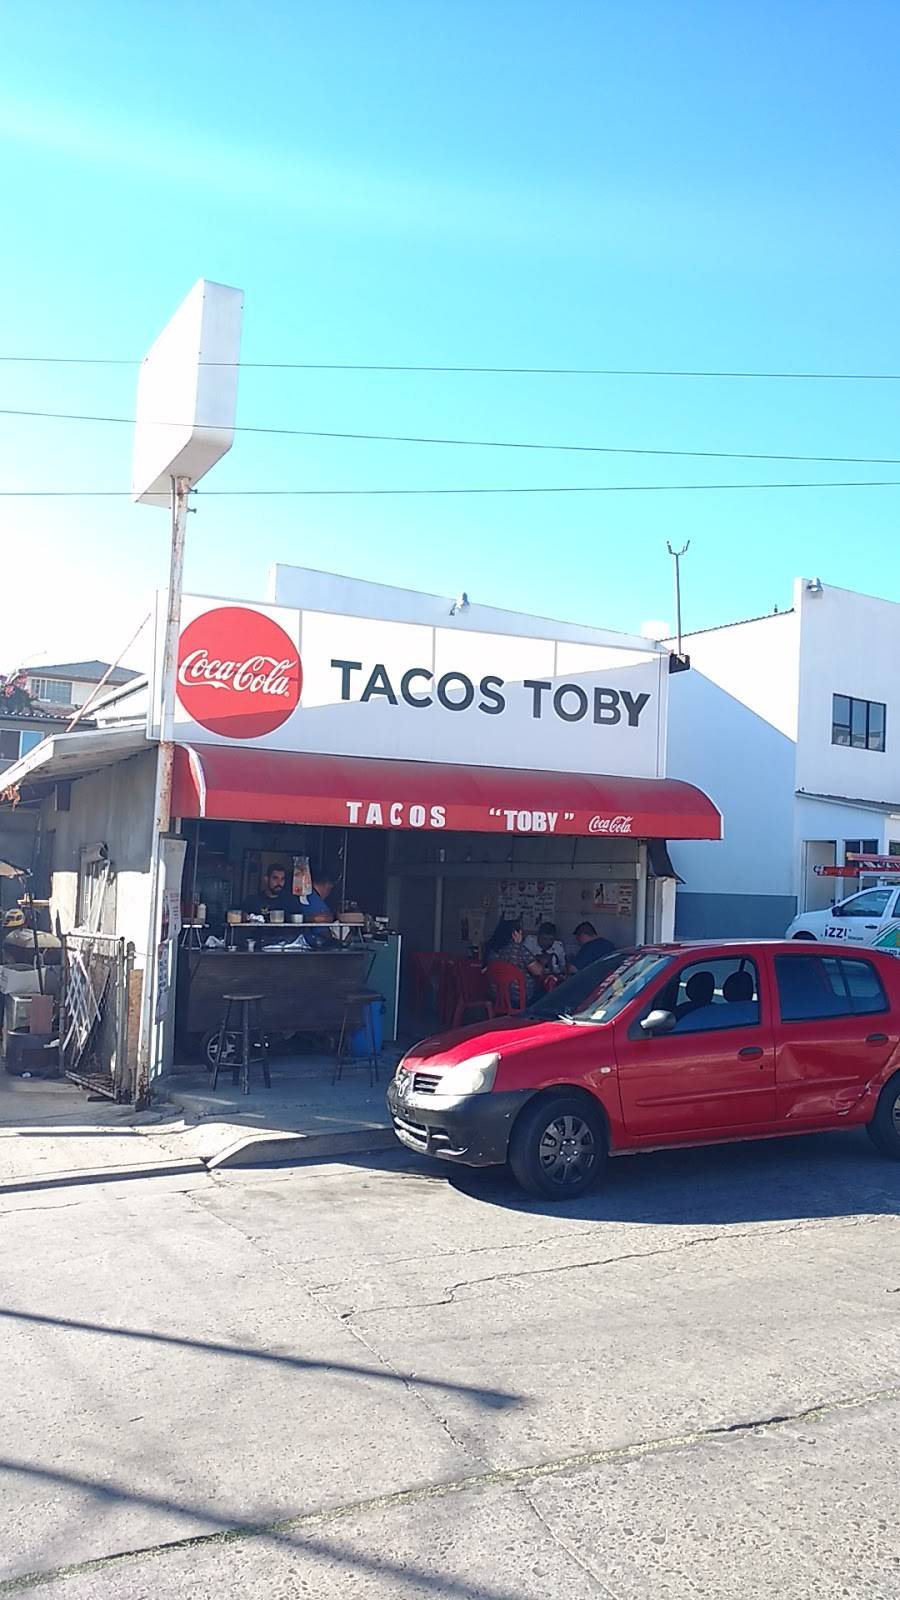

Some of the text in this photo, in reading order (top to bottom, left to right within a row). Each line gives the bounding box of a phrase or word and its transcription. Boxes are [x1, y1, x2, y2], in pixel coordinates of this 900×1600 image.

[178, 649, 297, 694] Coca-Cola
[331, 659, 651, 727] TACOS TOBY
[346, 801, 446, 827] TACOS
[588, 815, 634, 833] Coca-Cola
